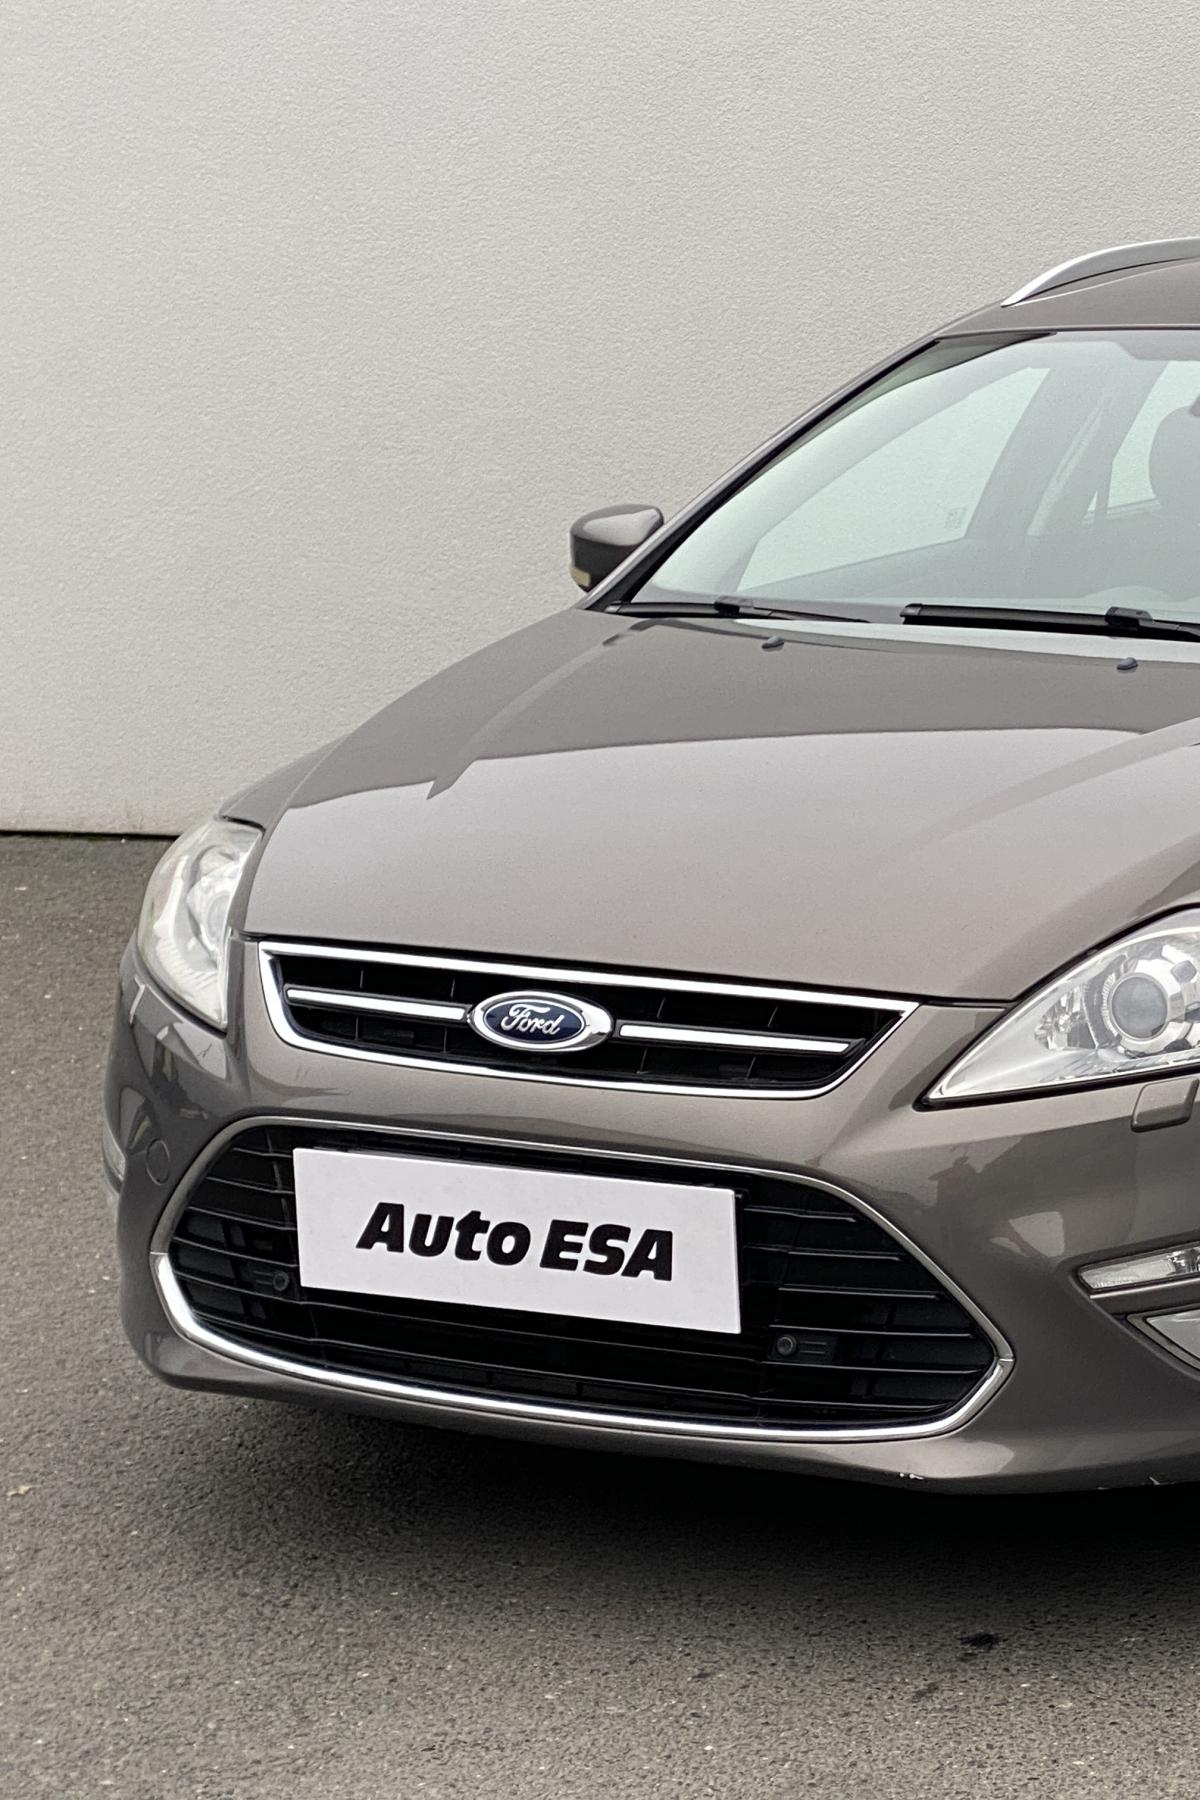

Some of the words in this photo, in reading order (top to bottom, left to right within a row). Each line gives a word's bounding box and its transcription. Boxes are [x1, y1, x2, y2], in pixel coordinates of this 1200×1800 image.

[500, 1003, 565, 1035] Ford
[355, 1202, 531, 1266] Auto
[539, 1219, 674, 1282] ESA
